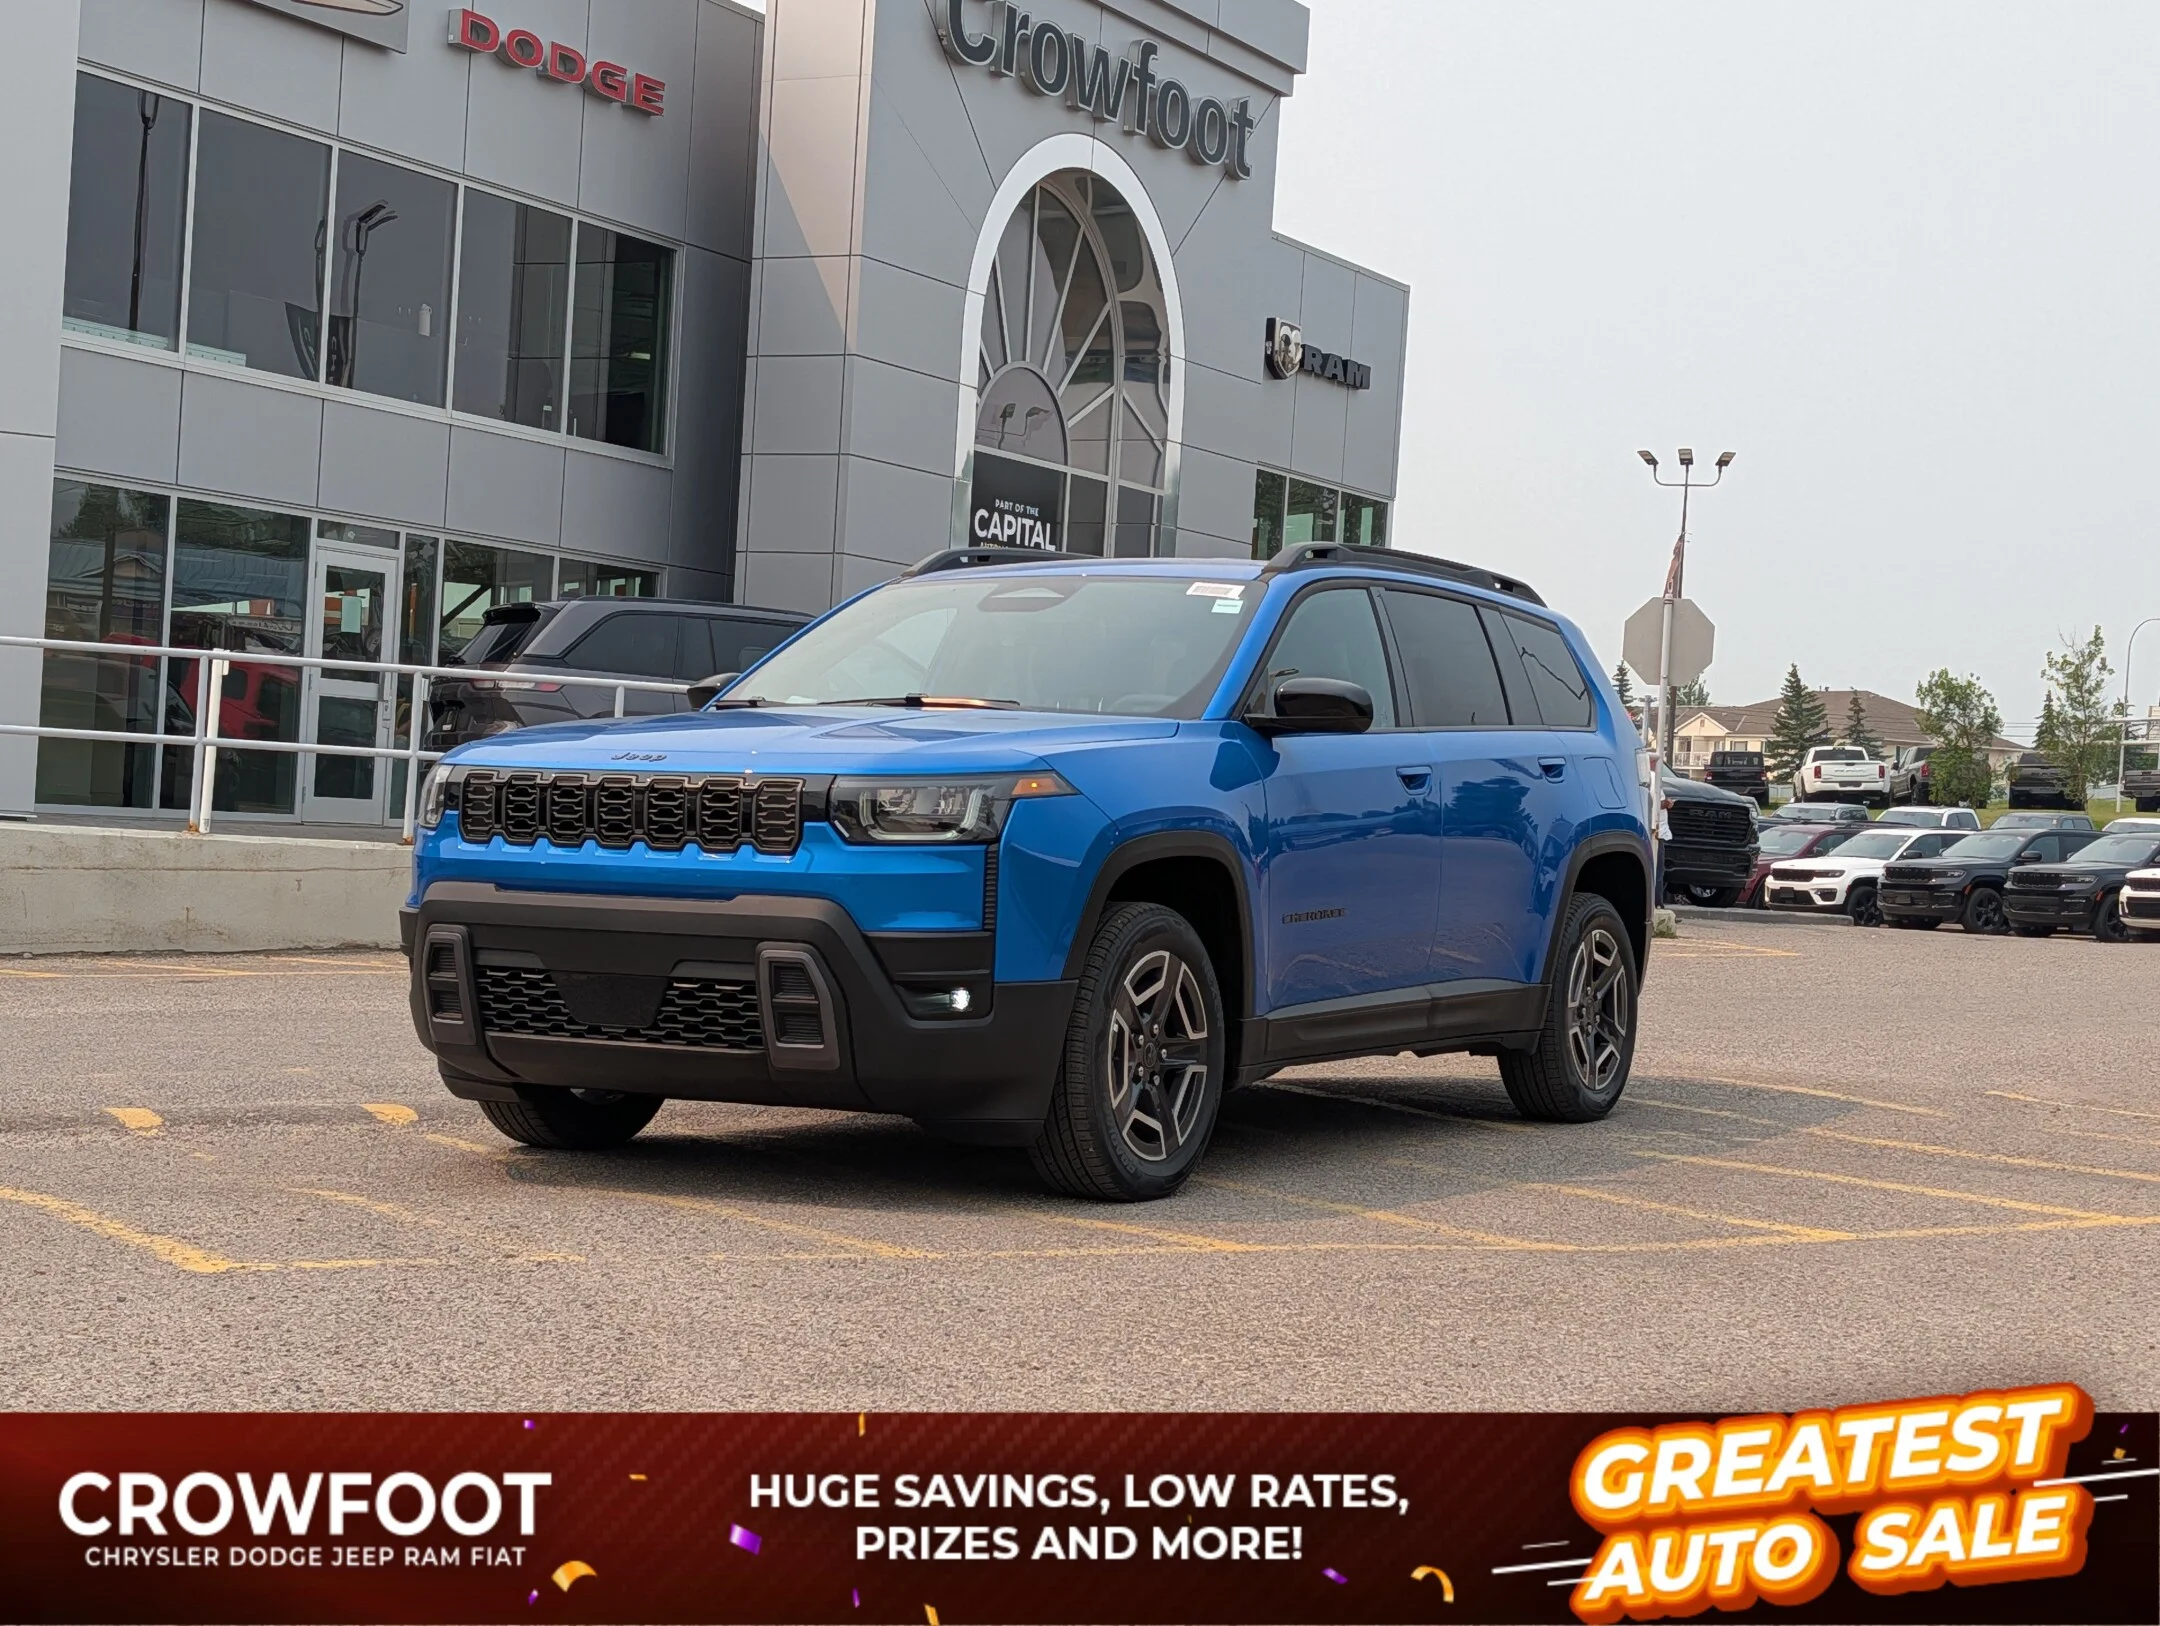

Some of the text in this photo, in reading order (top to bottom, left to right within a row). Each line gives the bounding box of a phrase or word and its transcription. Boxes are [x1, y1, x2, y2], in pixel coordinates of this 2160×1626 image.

[458, 8, 666, 117] DODGE
[944, 0, 1255, 181] Crowfoot
[1300, 343, 1372, 390] RAM
[974, 508, 1057, 552] CAPITAL
[995, 499, 1040, 517] PART OF THE
[610, 751, 668, 763] Jeep
